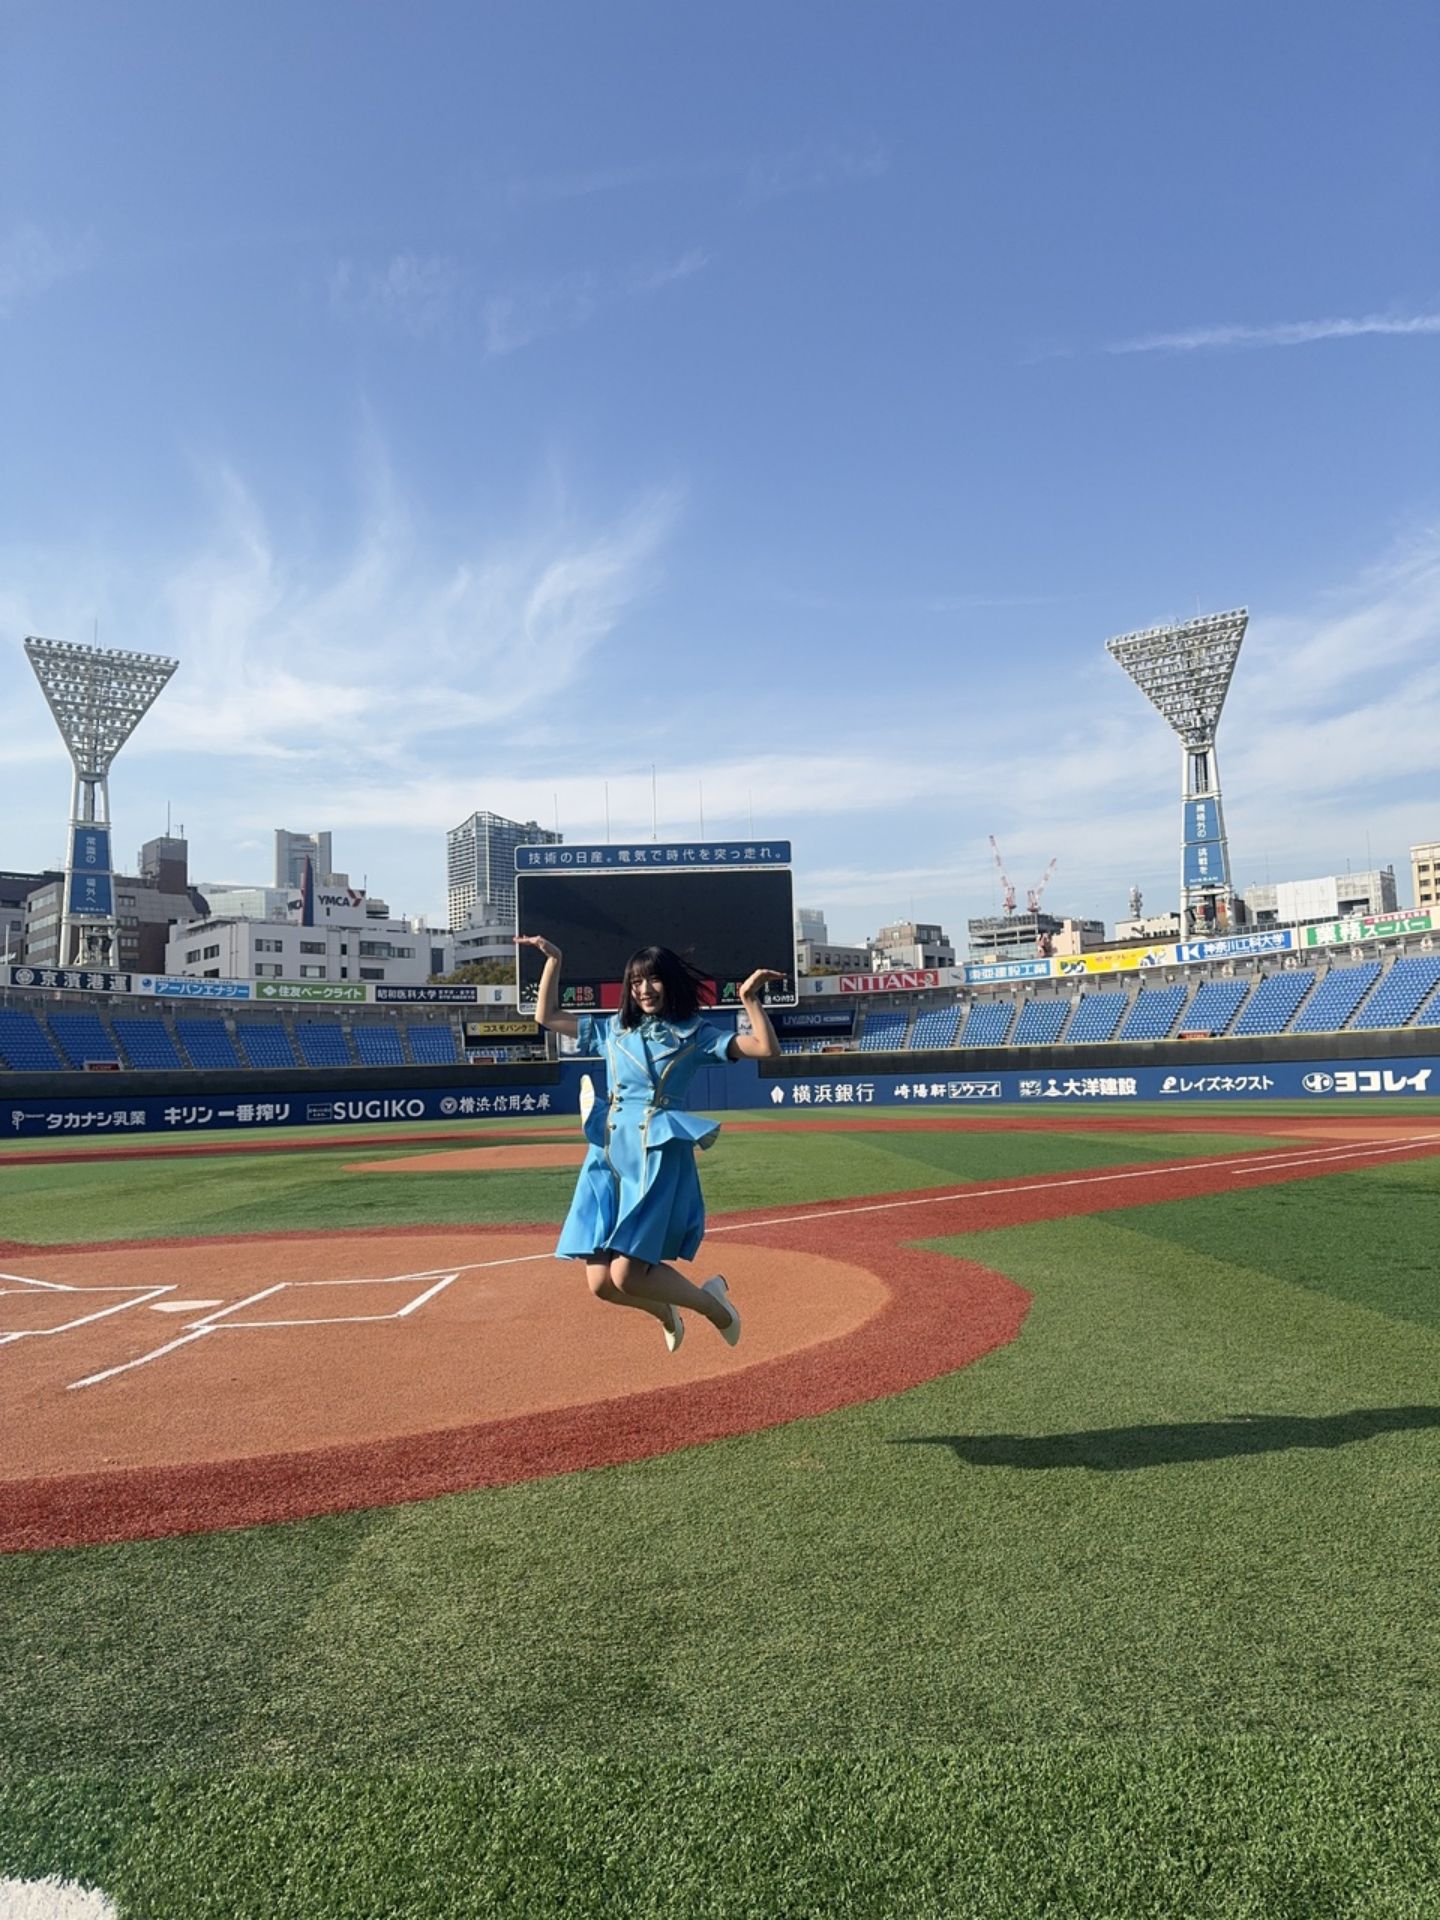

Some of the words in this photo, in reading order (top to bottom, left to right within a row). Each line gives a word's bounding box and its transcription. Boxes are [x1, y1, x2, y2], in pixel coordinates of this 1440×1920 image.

[318, 895, 350, 907] YMCA
[1203, 933, 1285, 955] 神奈川工科大学
[158, 982, 249, 996] アーバンエナジー
[841, 973, 918, 991] NITTAN
[279, 985, 362, 999] 住友ベークライト
[377, 989, 437, 1000] 昭和医科大学
[483, 1024, 528, 1033] コスモバンク
[1063, 1077, 1137, 1096] 大洋建設
[1179, 1075, 1274, 1092] レイズネクスト
[1334, 1069, 1432, 1092] ヨコレイ
[792, 1083, 875, 1104] 横浜銀行
[950, 1083, 999, 1097] シウマイ
[333, 1099, 425, 1120] SUGIKO
[458, 1093, 551, 1114] 横浜信用金庫
[46, 1110, 146, 1129] タカナシ乳業
